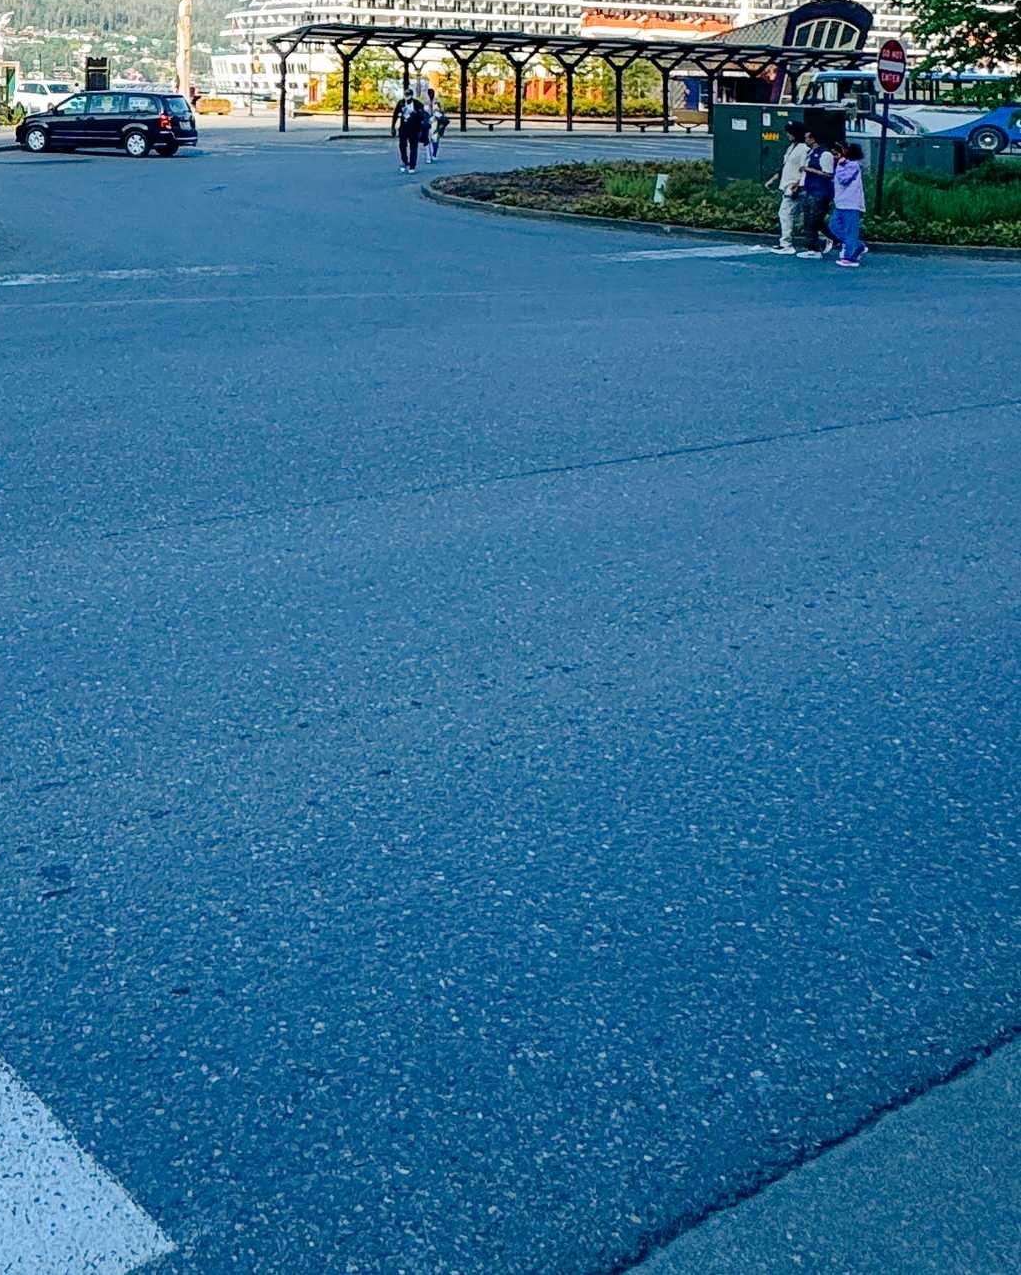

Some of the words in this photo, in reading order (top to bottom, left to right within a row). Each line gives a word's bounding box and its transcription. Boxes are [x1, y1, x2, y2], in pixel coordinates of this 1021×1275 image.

[882, 49, 890, 58] DO
[892, 51, 902, 59] NOT
[882, 73, 900, 83] ENTER
